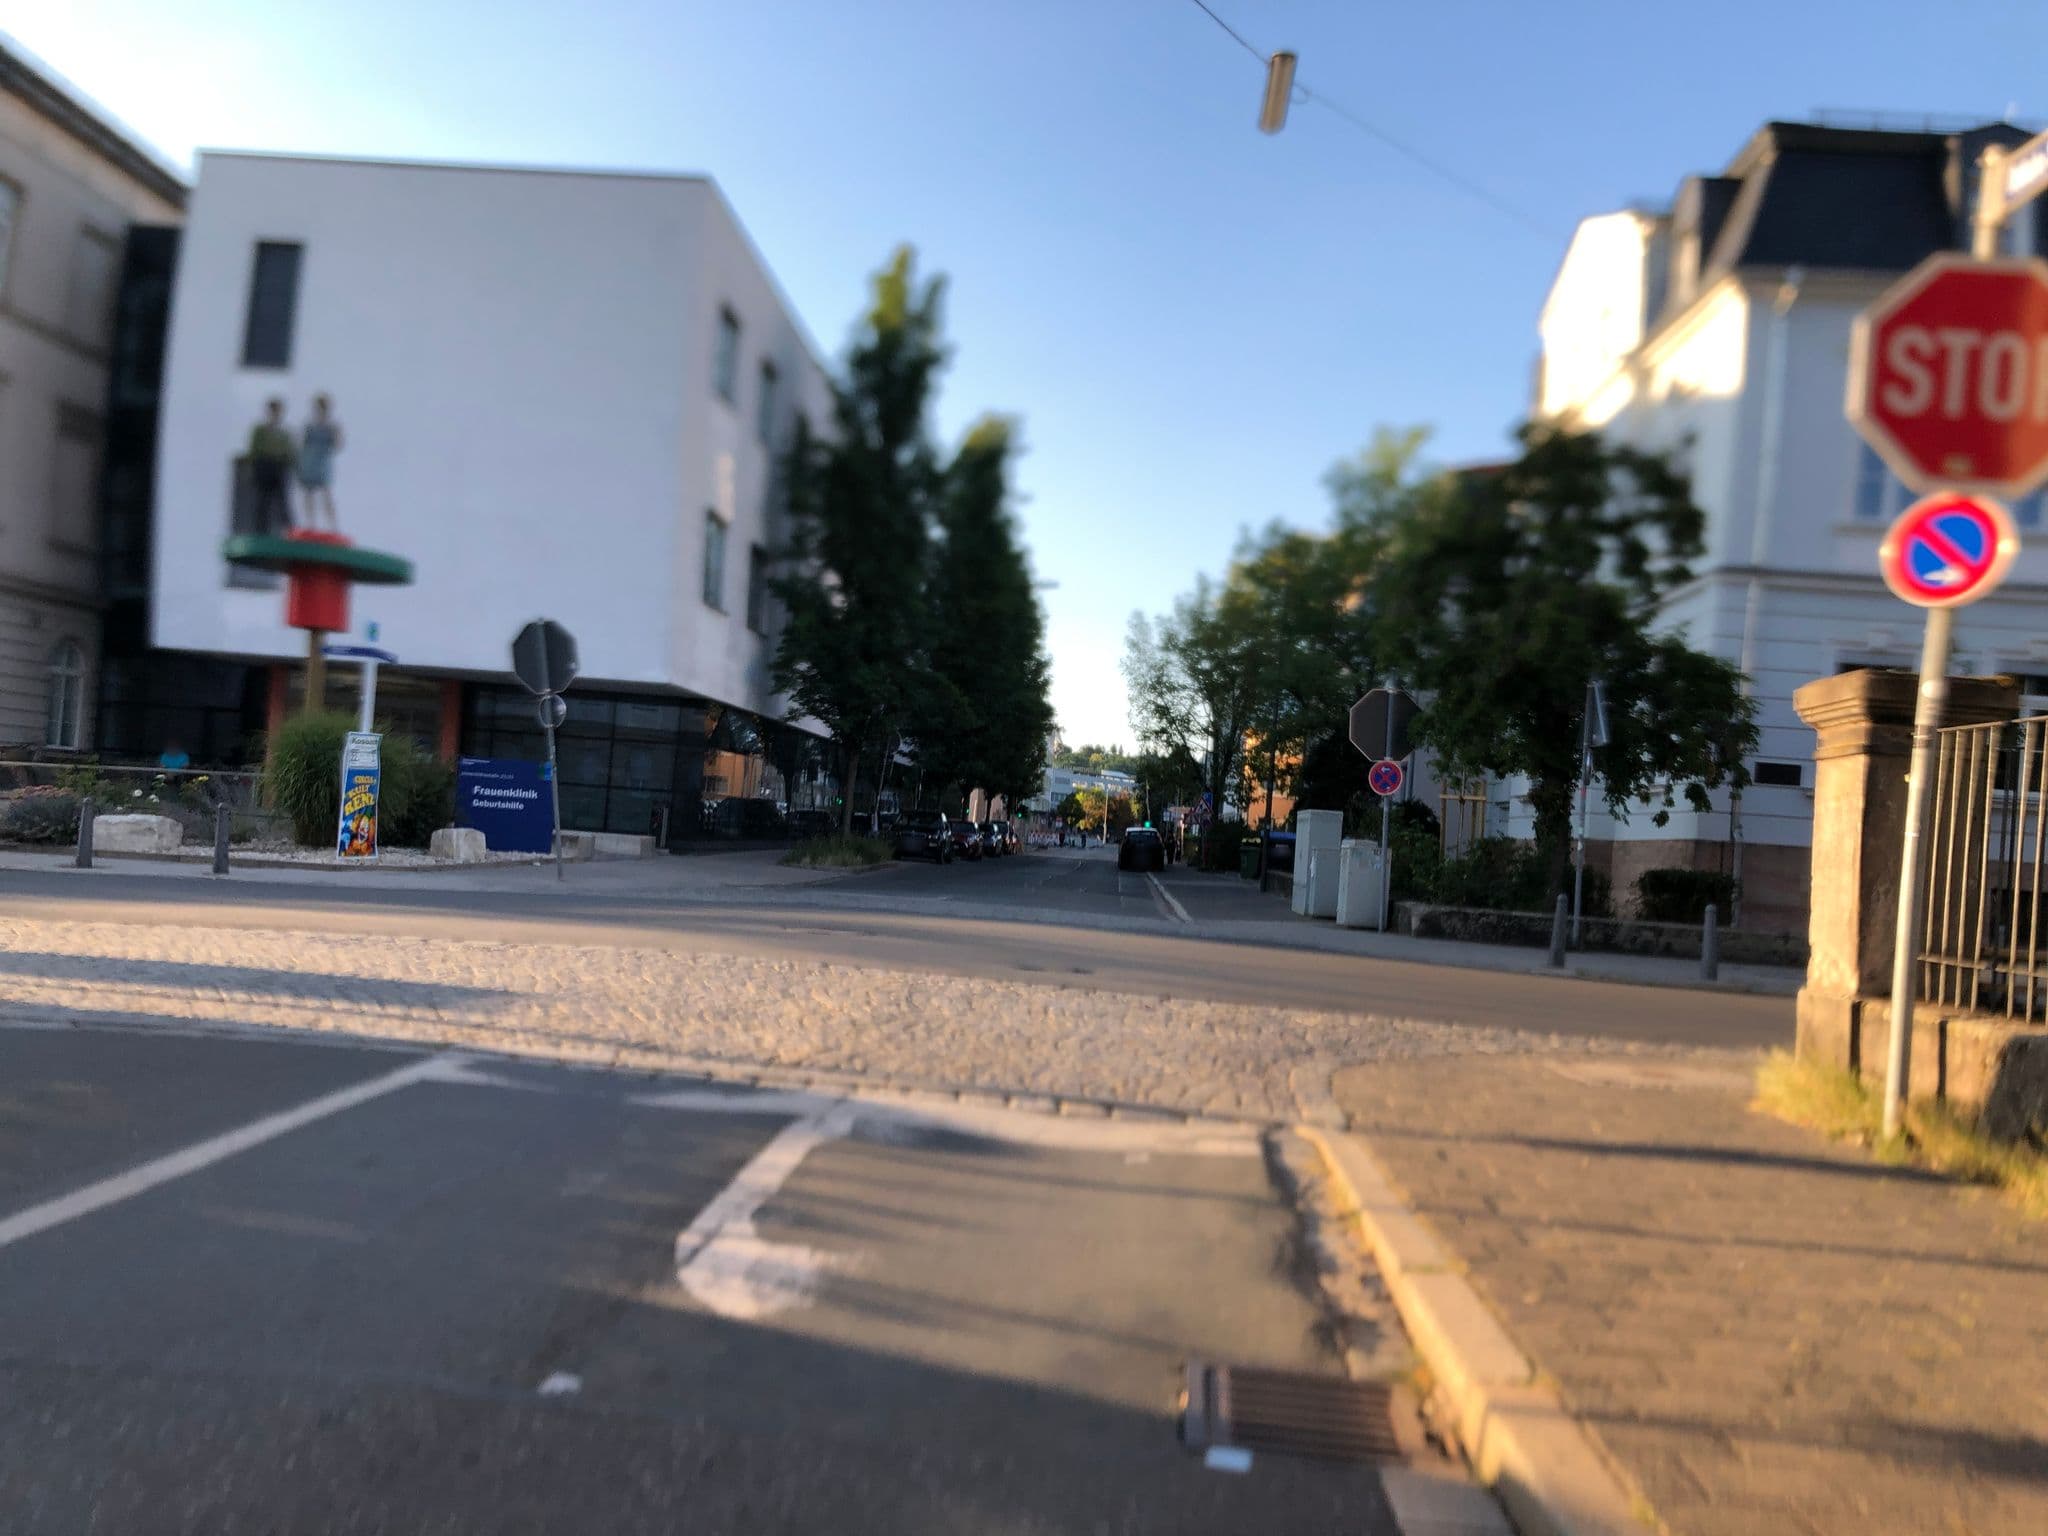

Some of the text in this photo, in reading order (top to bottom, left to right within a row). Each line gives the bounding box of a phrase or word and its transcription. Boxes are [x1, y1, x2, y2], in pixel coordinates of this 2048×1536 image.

[1883, 326, 2048, 423] STO
[473, 785, 538, 799] Frauenklinik
[472, 798, 525, 810] Geburtshilfe
